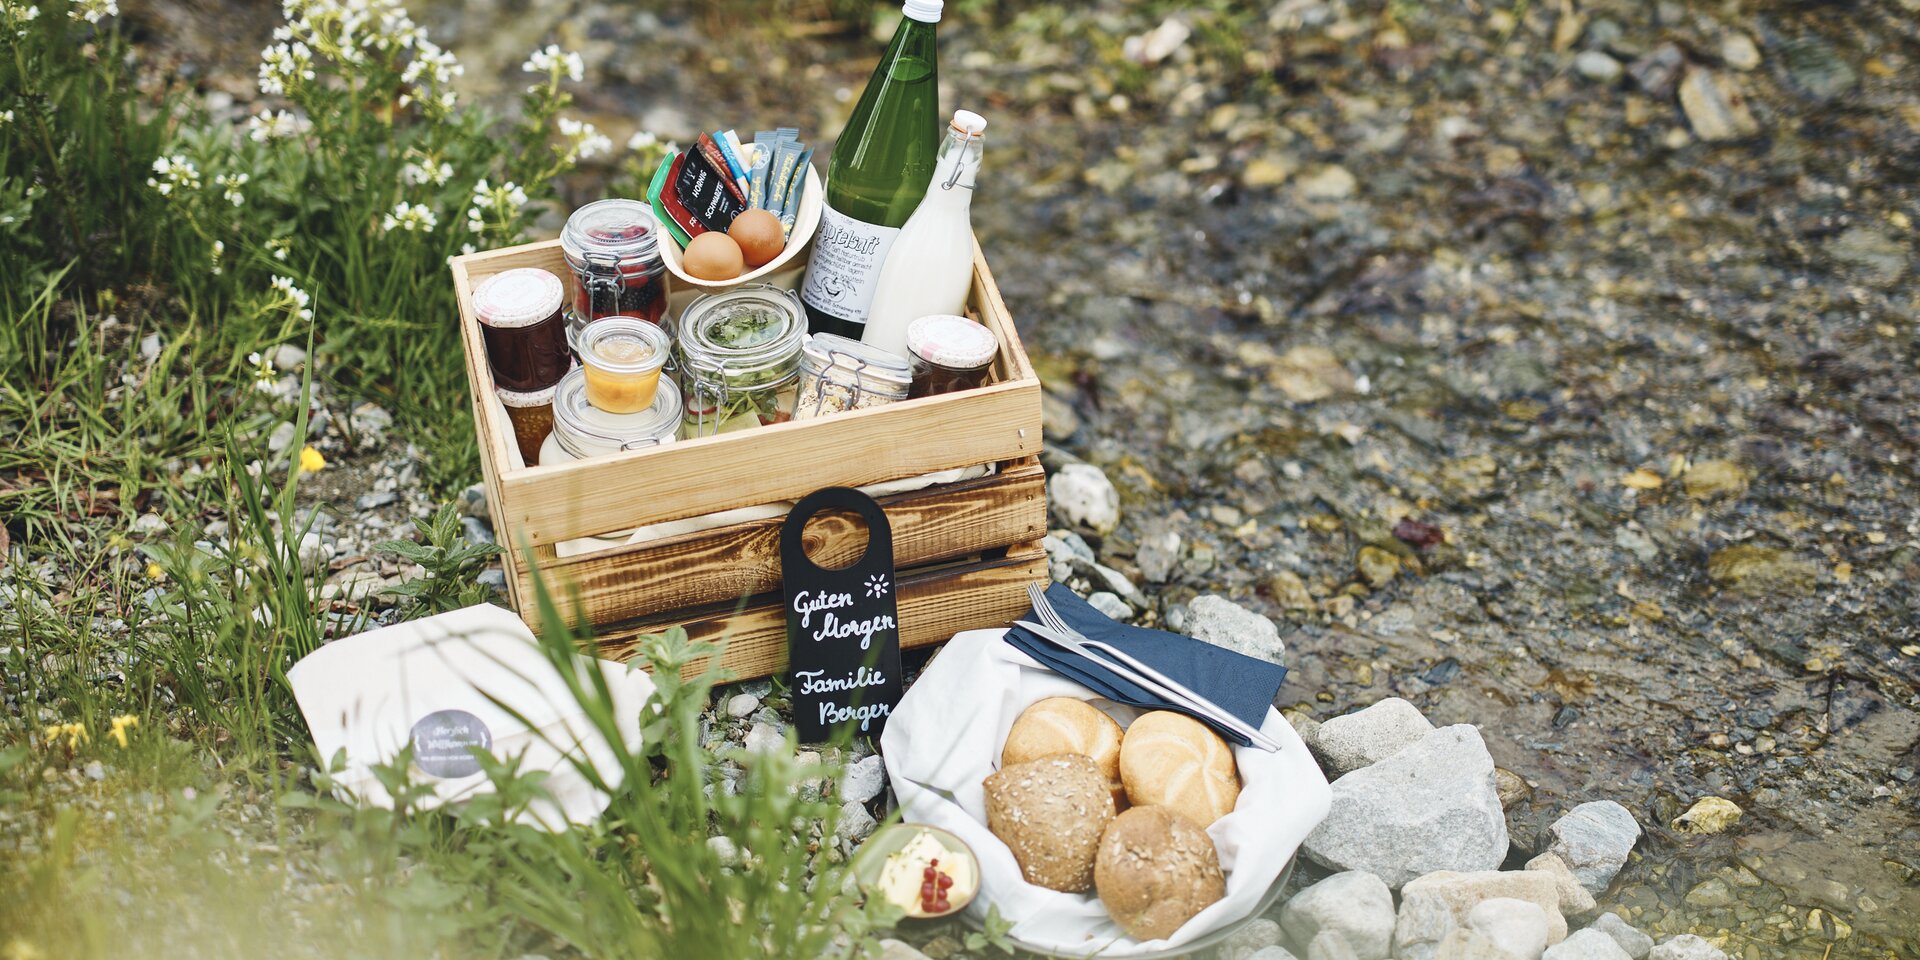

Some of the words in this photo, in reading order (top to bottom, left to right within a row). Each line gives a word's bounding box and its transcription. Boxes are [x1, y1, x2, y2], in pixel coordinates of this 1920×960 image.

[691, 169, 708, 198] HORNIG
[820, 217, 881, 256] Apfelsaft
[794, 590, 854, 629] Guten
[812, 612, 896, 650] Morgen
[795, 666, 886, 695] Familie
[819, 701, 891, 732] Berger
